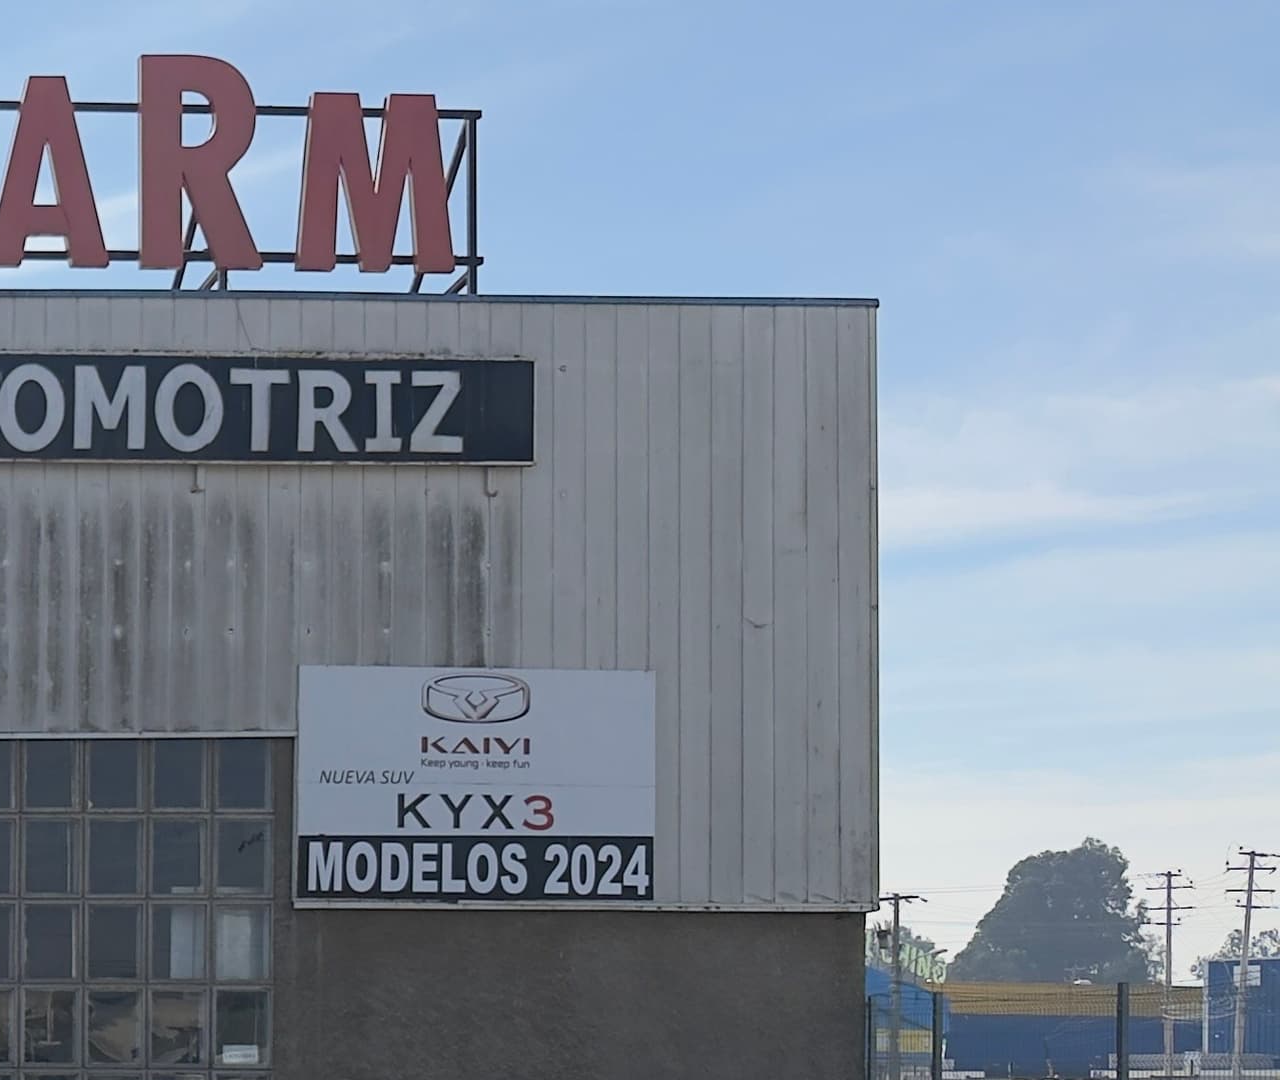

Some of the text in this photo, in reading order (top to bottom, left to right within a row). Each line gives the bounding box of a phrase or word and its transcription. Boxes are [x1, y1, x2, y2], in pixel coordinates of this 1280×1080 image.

[421, 736, 531, 755] KAIYI
[420, 758, 531, 770] Keep young keep fun
[319, 769, 414, 785] NUEVA SUV
[397, 793, 554, 831] KYX3
[306, 841, 649, 896] MODELOS 2024
